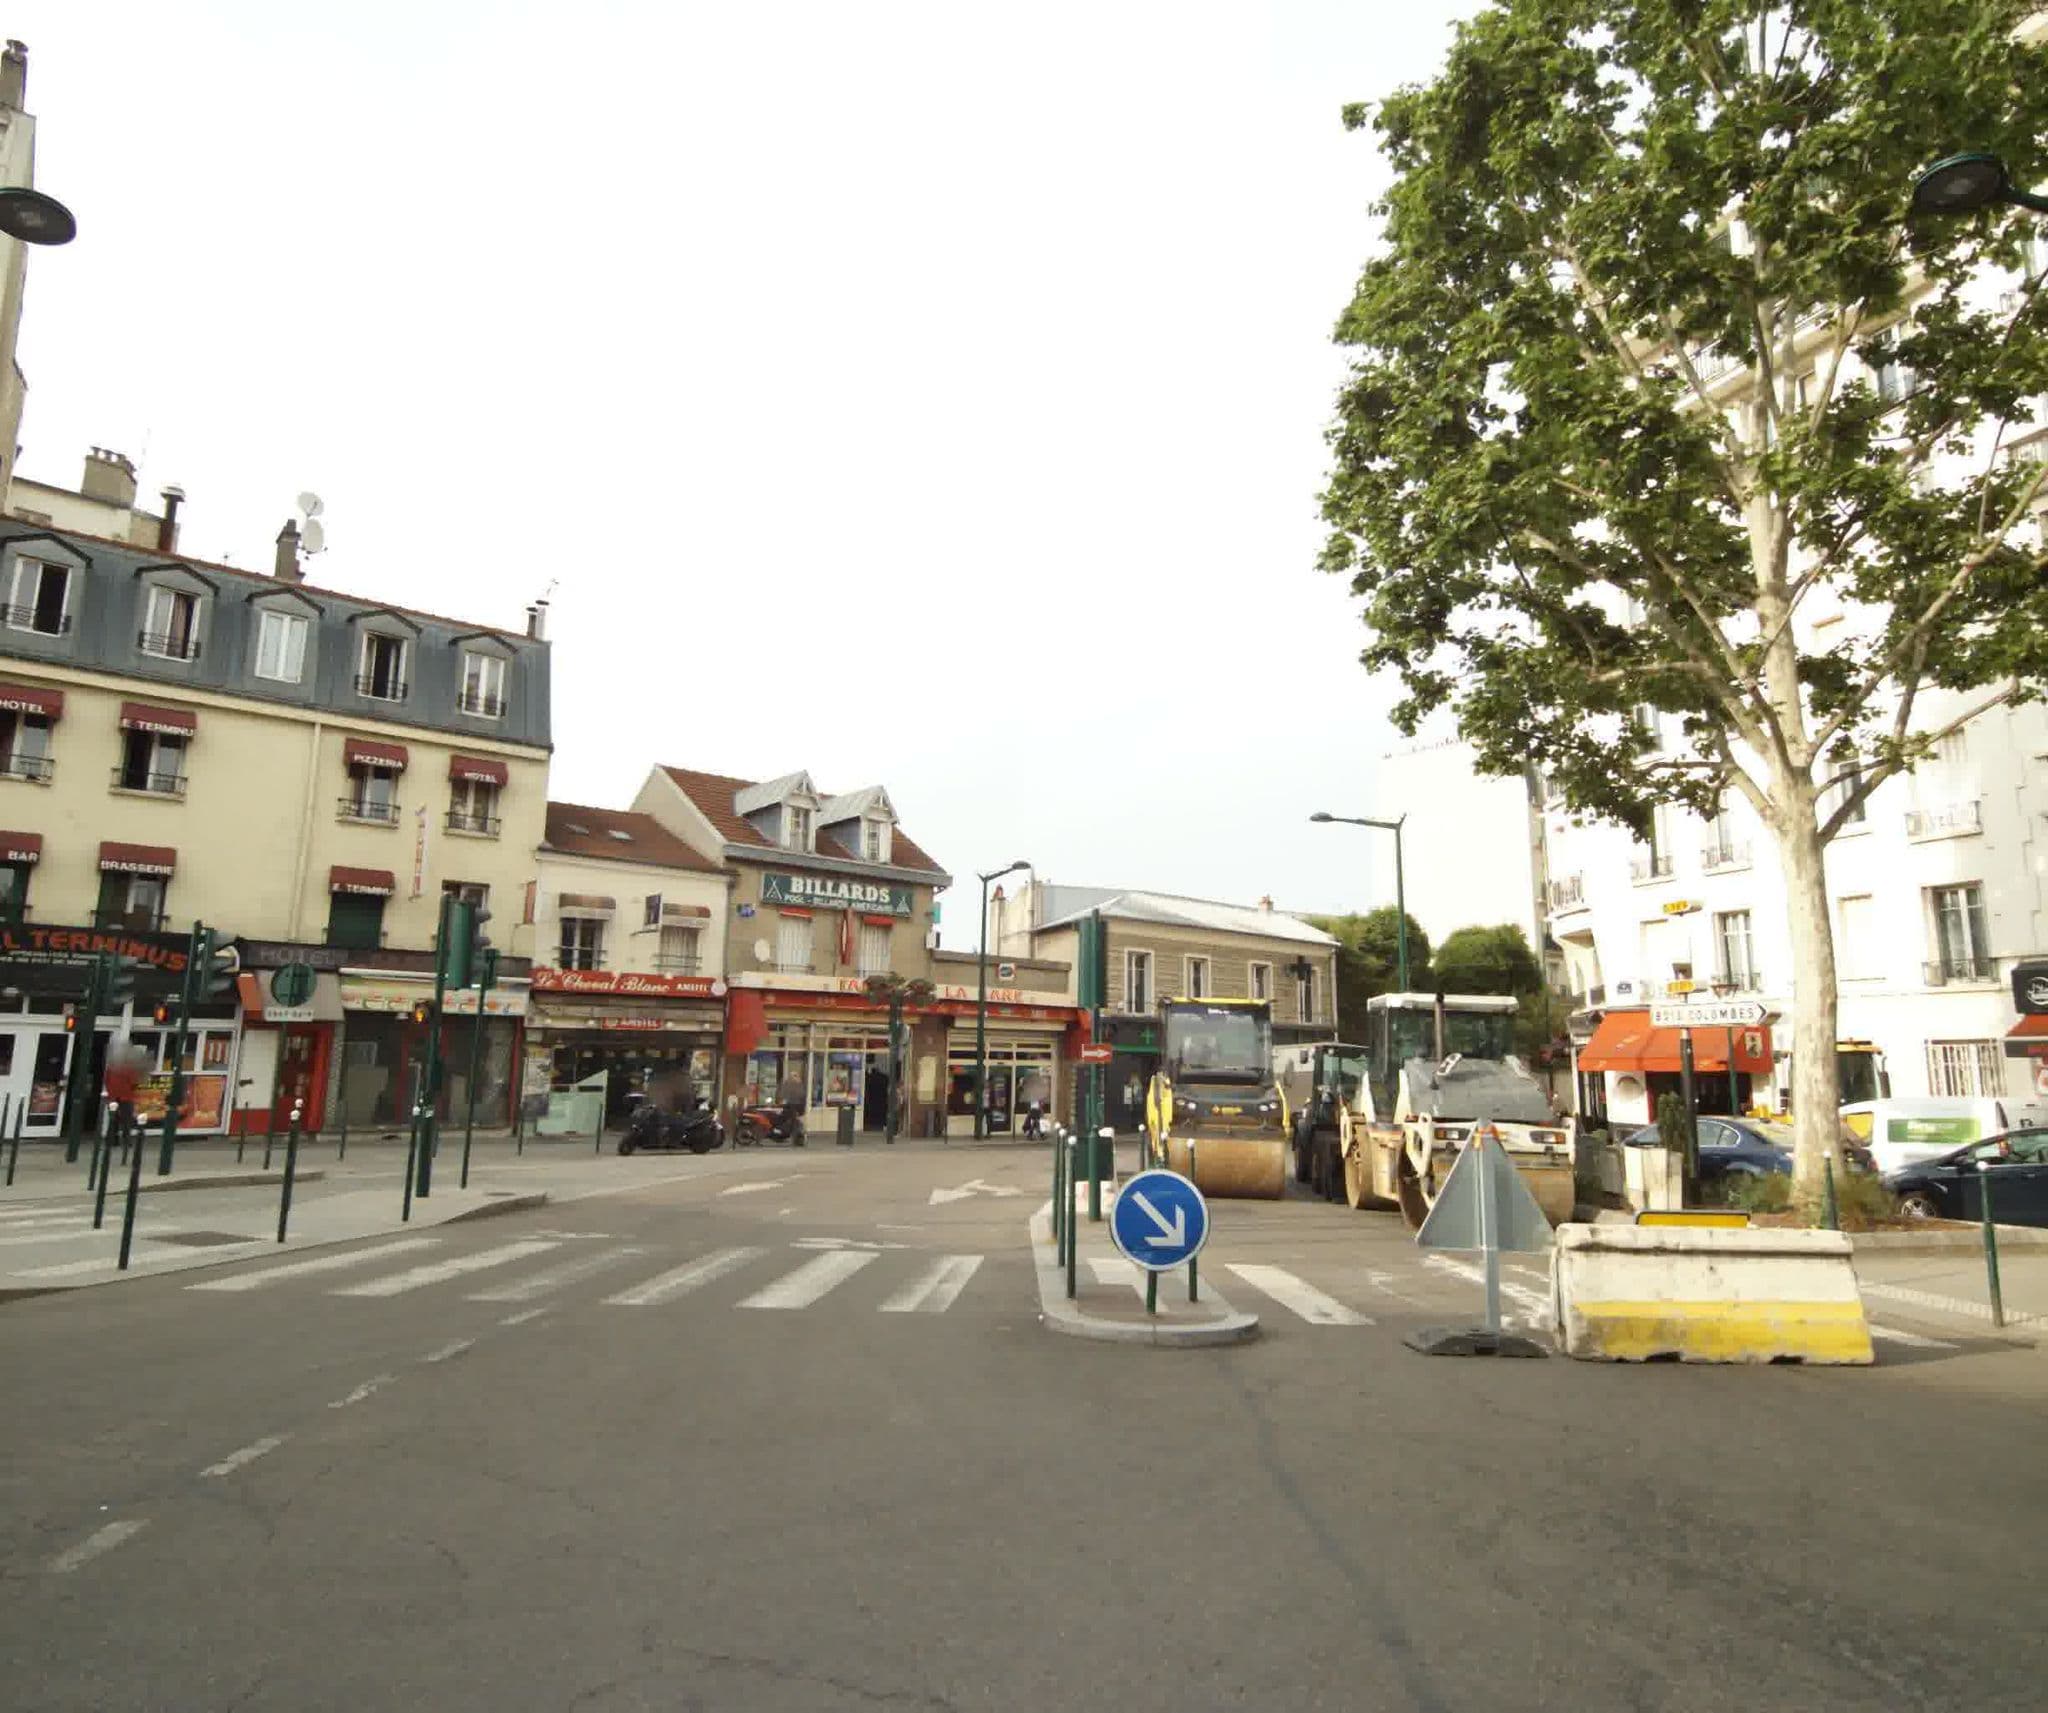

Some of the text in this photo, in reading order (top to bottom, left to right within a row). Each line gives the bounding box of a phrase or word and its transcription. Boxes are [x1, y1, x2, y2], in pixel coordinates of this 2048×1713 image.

[0, 699, 45, 714] HOTEL
[8, 850, 38, 862] BAR
[101, 859, 175, 875] BRASSERIE
[789, 876, 891, 904] BILLARDS
[31, 929, 189, 971] TERMINUS
[620, 975, 670, 993] Blanc
